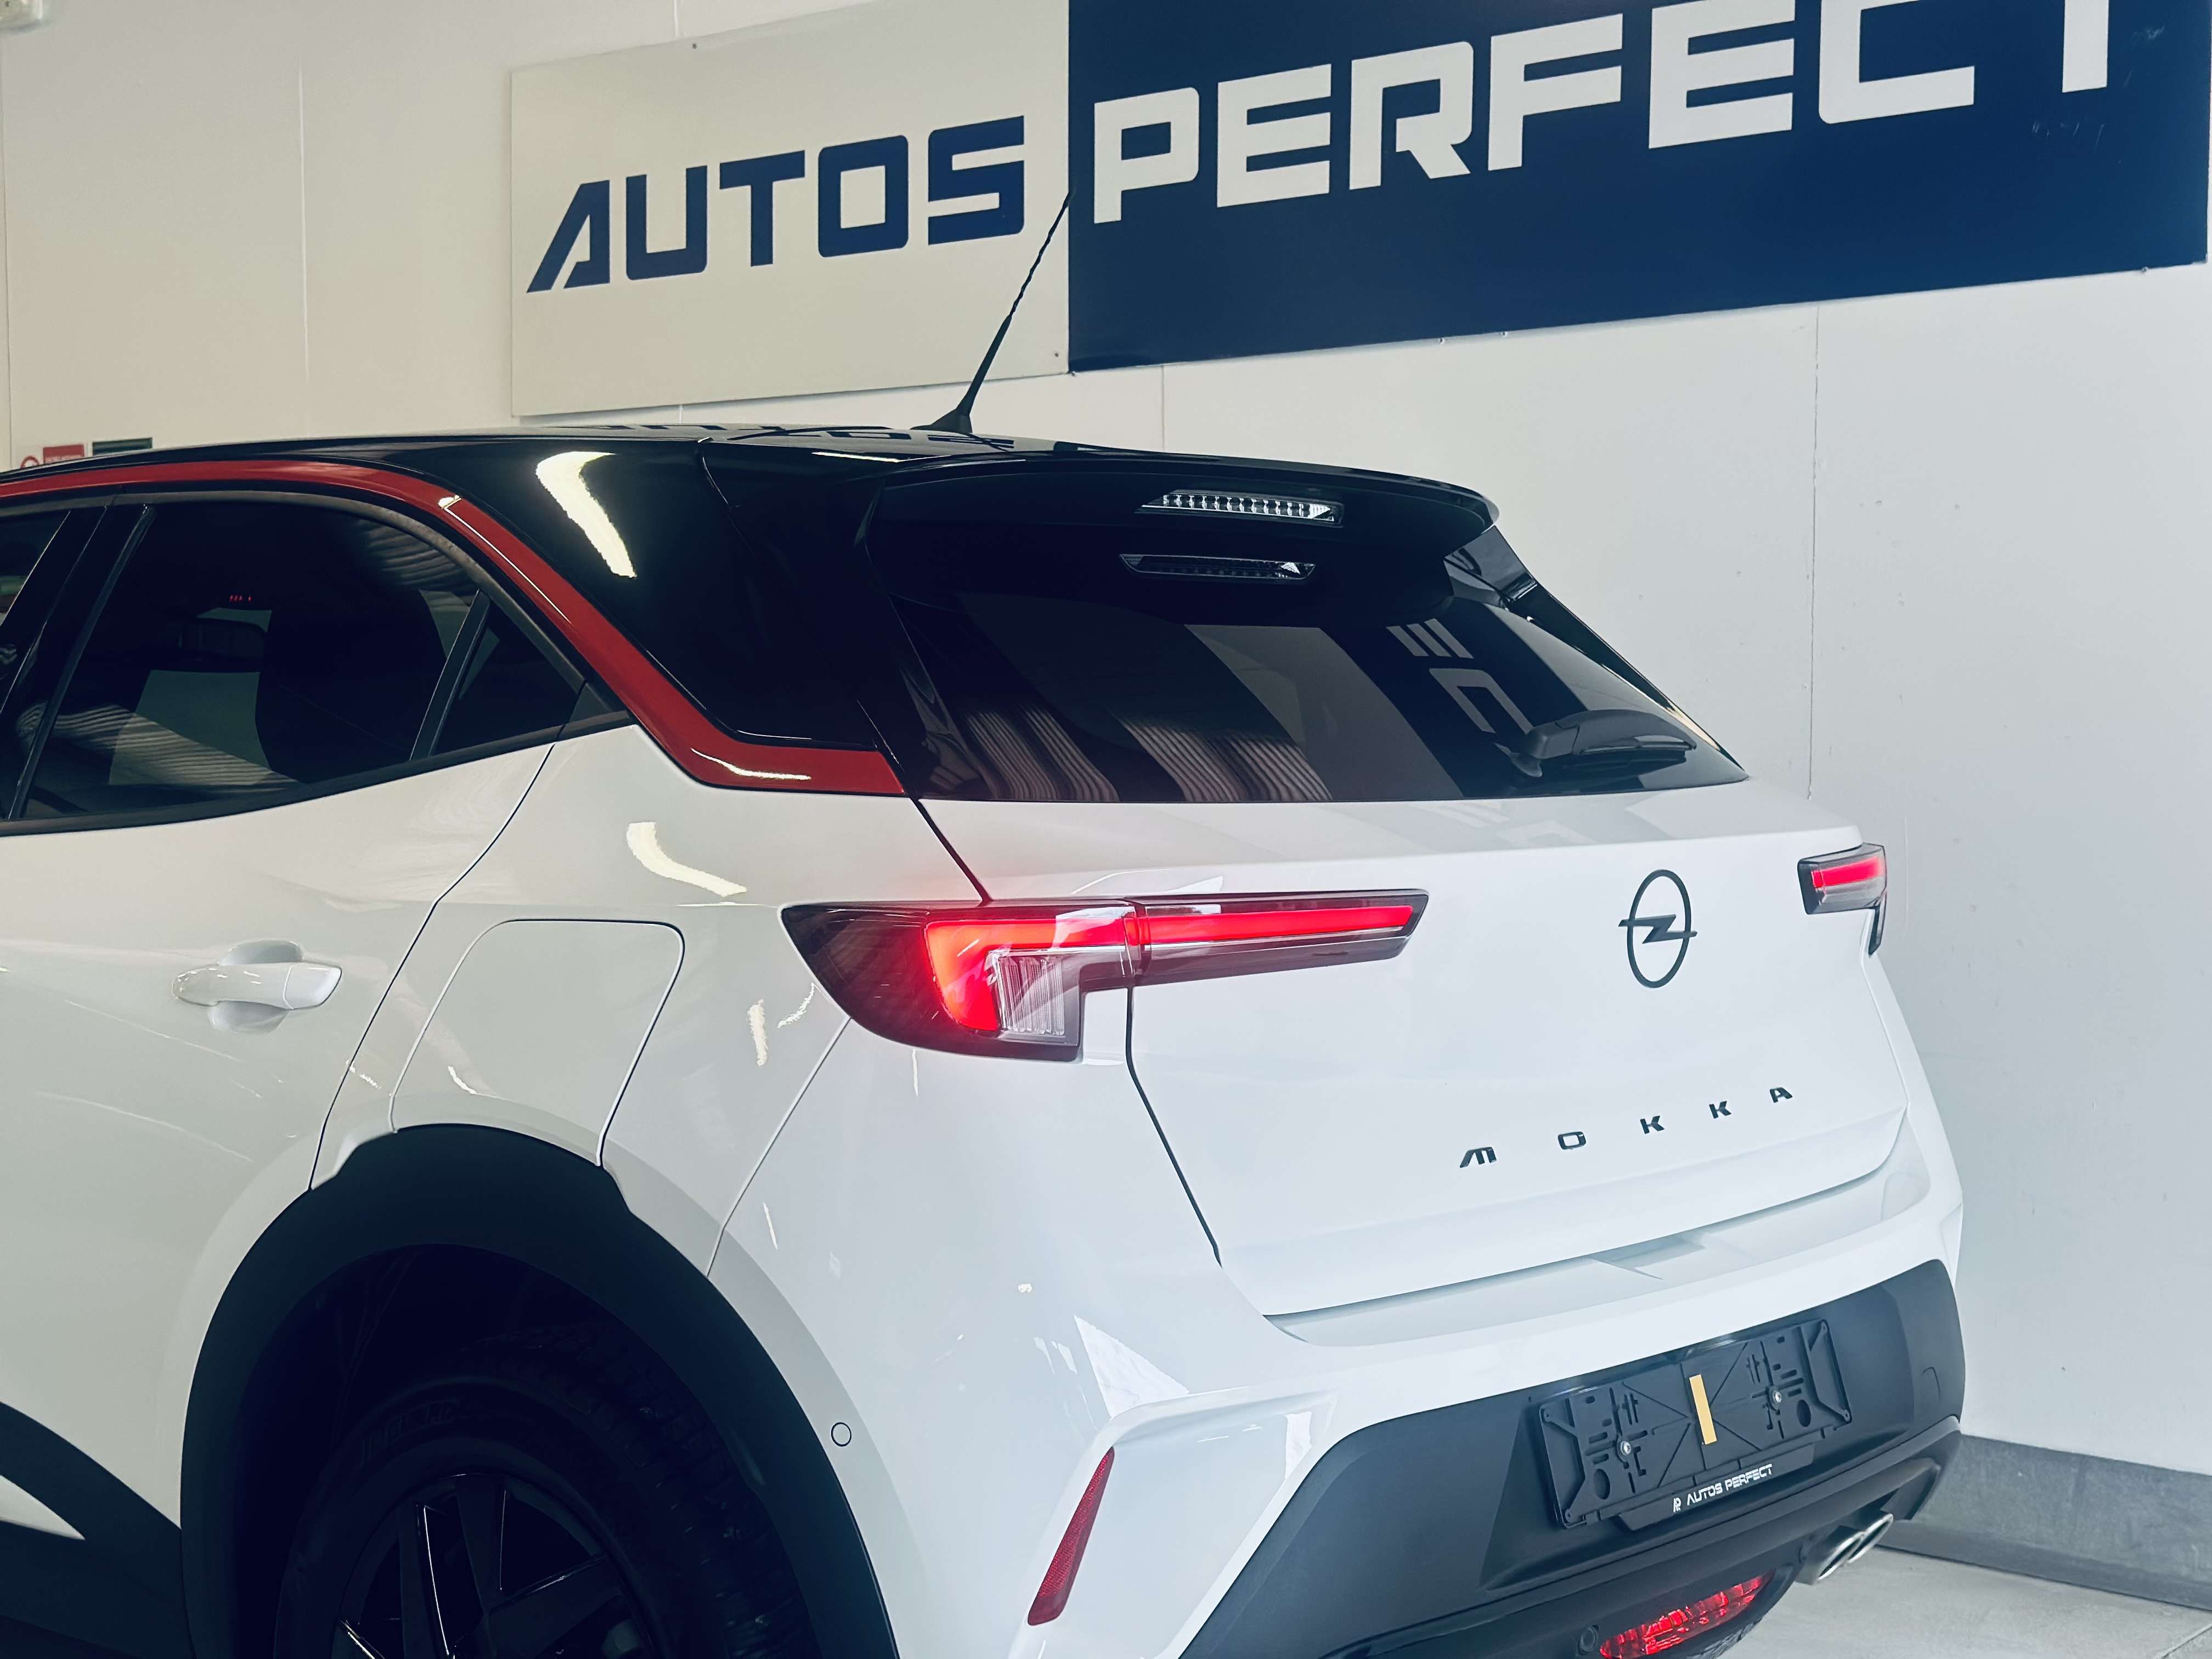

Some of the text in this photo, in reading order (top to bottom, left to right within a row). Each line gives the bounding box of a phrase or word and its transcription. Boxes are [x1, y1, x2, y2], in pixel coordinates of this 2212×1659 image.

[527, 115, 1024, 293] AUTOS
[1459, 1086, 1793, 1167] MOKKA
[1687, 1463, 1773, 1505] AUTOS PERFECT
